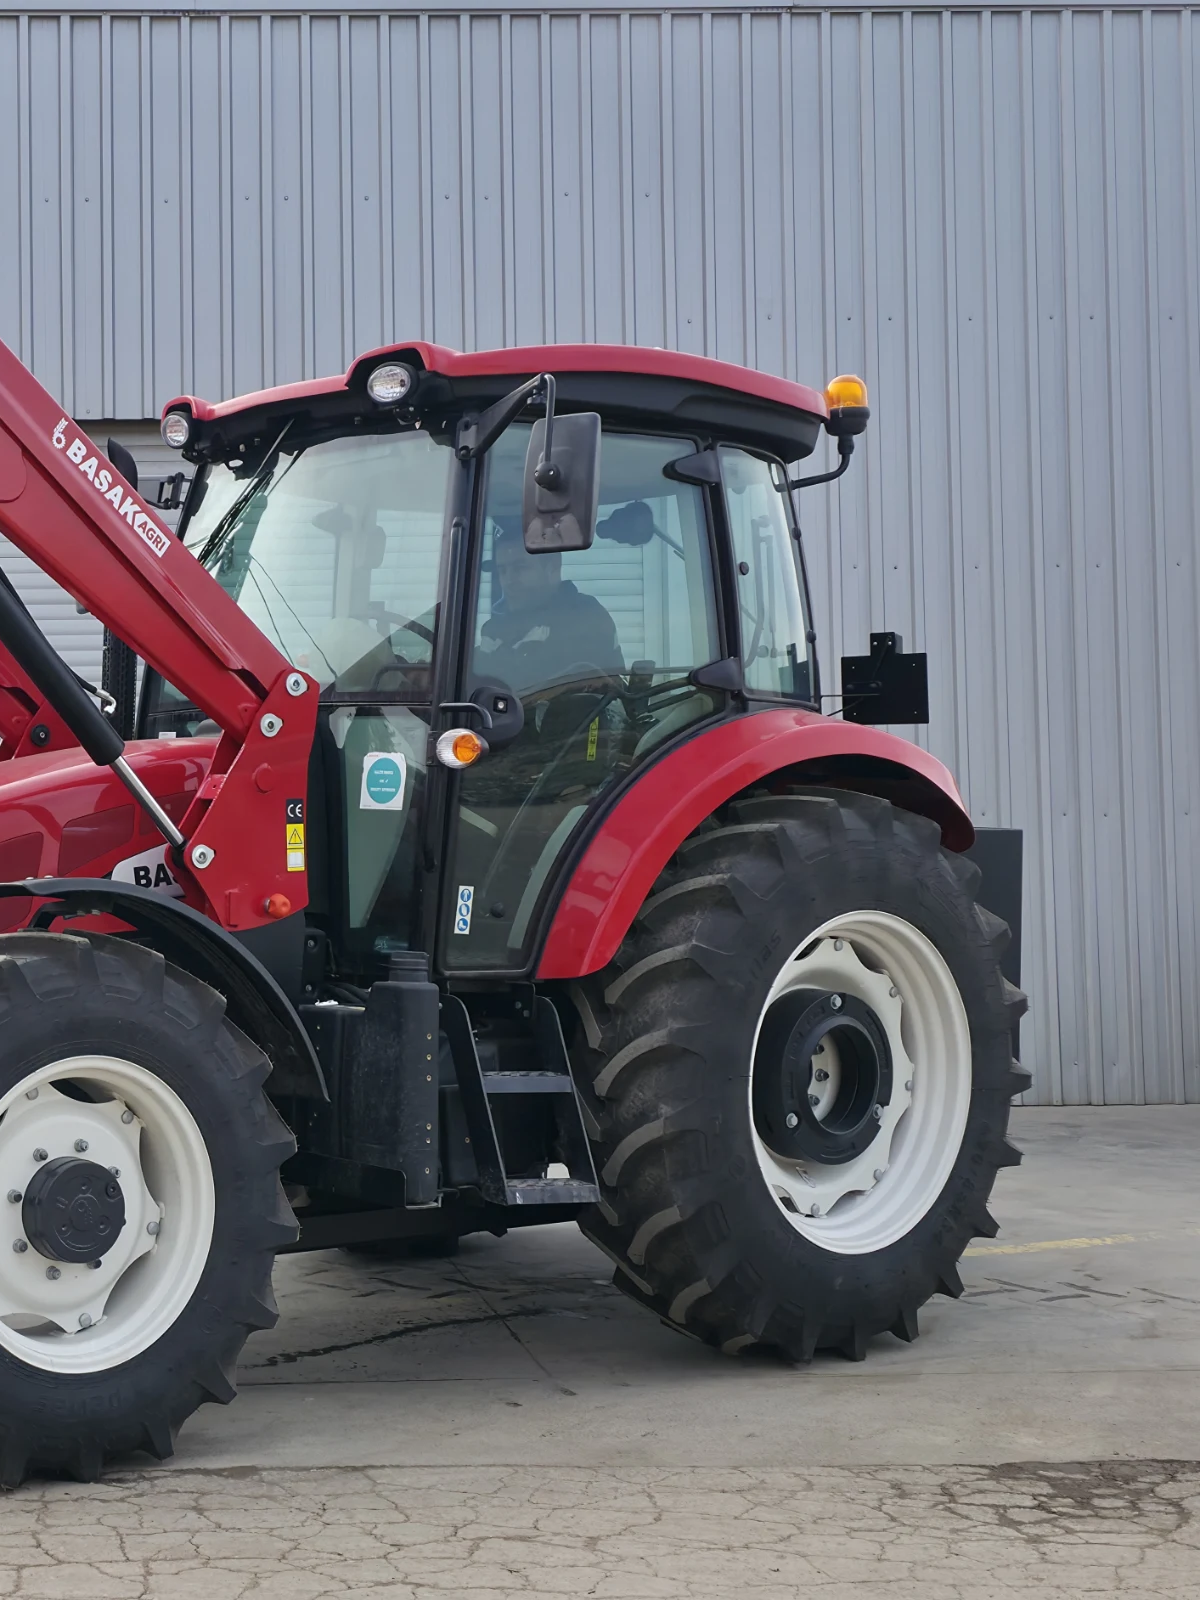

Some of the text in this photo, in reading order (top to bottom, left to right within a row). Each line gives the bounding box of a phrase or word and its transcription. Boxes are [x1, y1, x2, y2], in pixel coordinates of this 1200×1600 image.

[66, 438, 166, 551] BASAK AGRI
[287, 803, 303, 817] CE
[133, 863, 178, 888] BA
